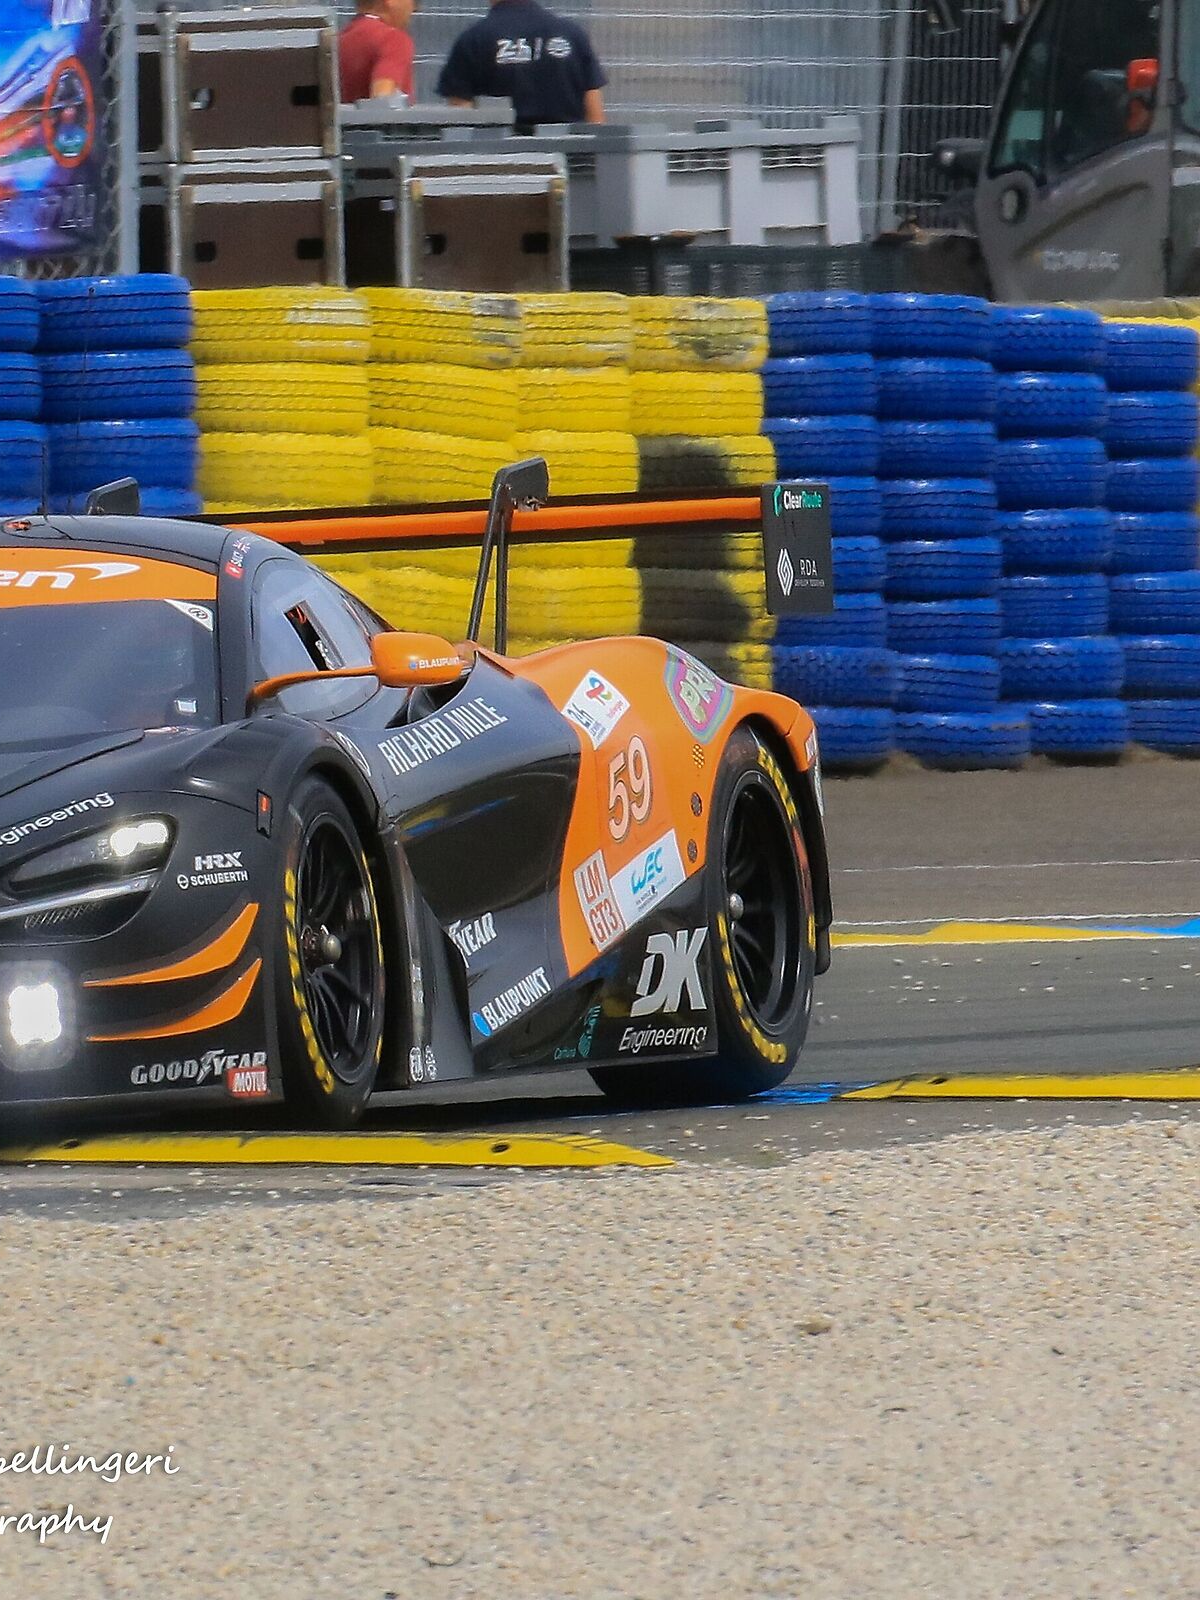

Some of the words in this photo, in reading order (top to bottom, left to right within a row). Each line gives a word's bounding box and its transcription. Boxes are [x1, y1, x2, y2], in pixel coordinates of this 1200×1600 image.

[799, 559, 818, 577] RDA
[377, 717, 462, 776] RICHARD
[443, 697, 509, 741] MILLE
[609, 735, 652, 843] 59
[190, 870, 249, 887] SCHUBERTH
[194, 850, 243, 872] HRX
[580, 860, 605, 904] LM
[589, 898, 619, 943] GT3
[629, 926, 709, 1018] DK
[481, 966, 552, 1031] BLAUPUNKT
[618, 1024, 708, 1053] Engineering
[232, 1070, 267, 1092] MOTUL
